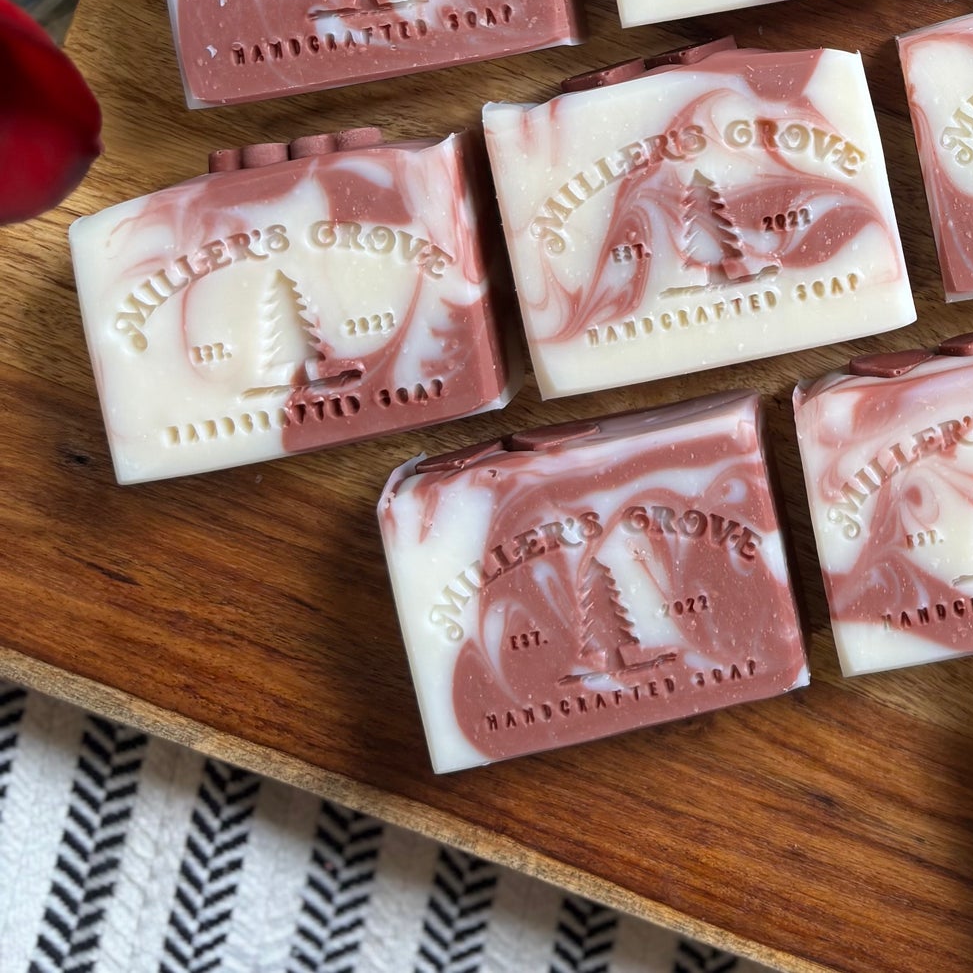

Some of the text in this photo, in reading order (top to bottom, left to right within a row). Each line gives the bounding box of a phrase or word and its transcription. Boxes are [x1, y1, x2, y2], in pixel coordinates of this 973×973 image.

[233, 5, 513, 64] HANDCRAFTED SOAP
[530, 120, 865, 254] MILLER'S GROVE
[612, 209, 811, 262] EST. 2022
[116, 221, 453, 353] MILLER'S GROVE
[587, 274, 861, 346] HANDCRAFTED SOAP
[345, 313, 395, 336] 2022
[378, 379, 443, 408] SOAP
[905, 531, 945, 548] EST.
[430, 506, 761, 642] MILLER'S GROVE
[510, 596, 708, 650] EST. 2022
[486, 661, 757, 731] HANDCRAFTED SOAP
